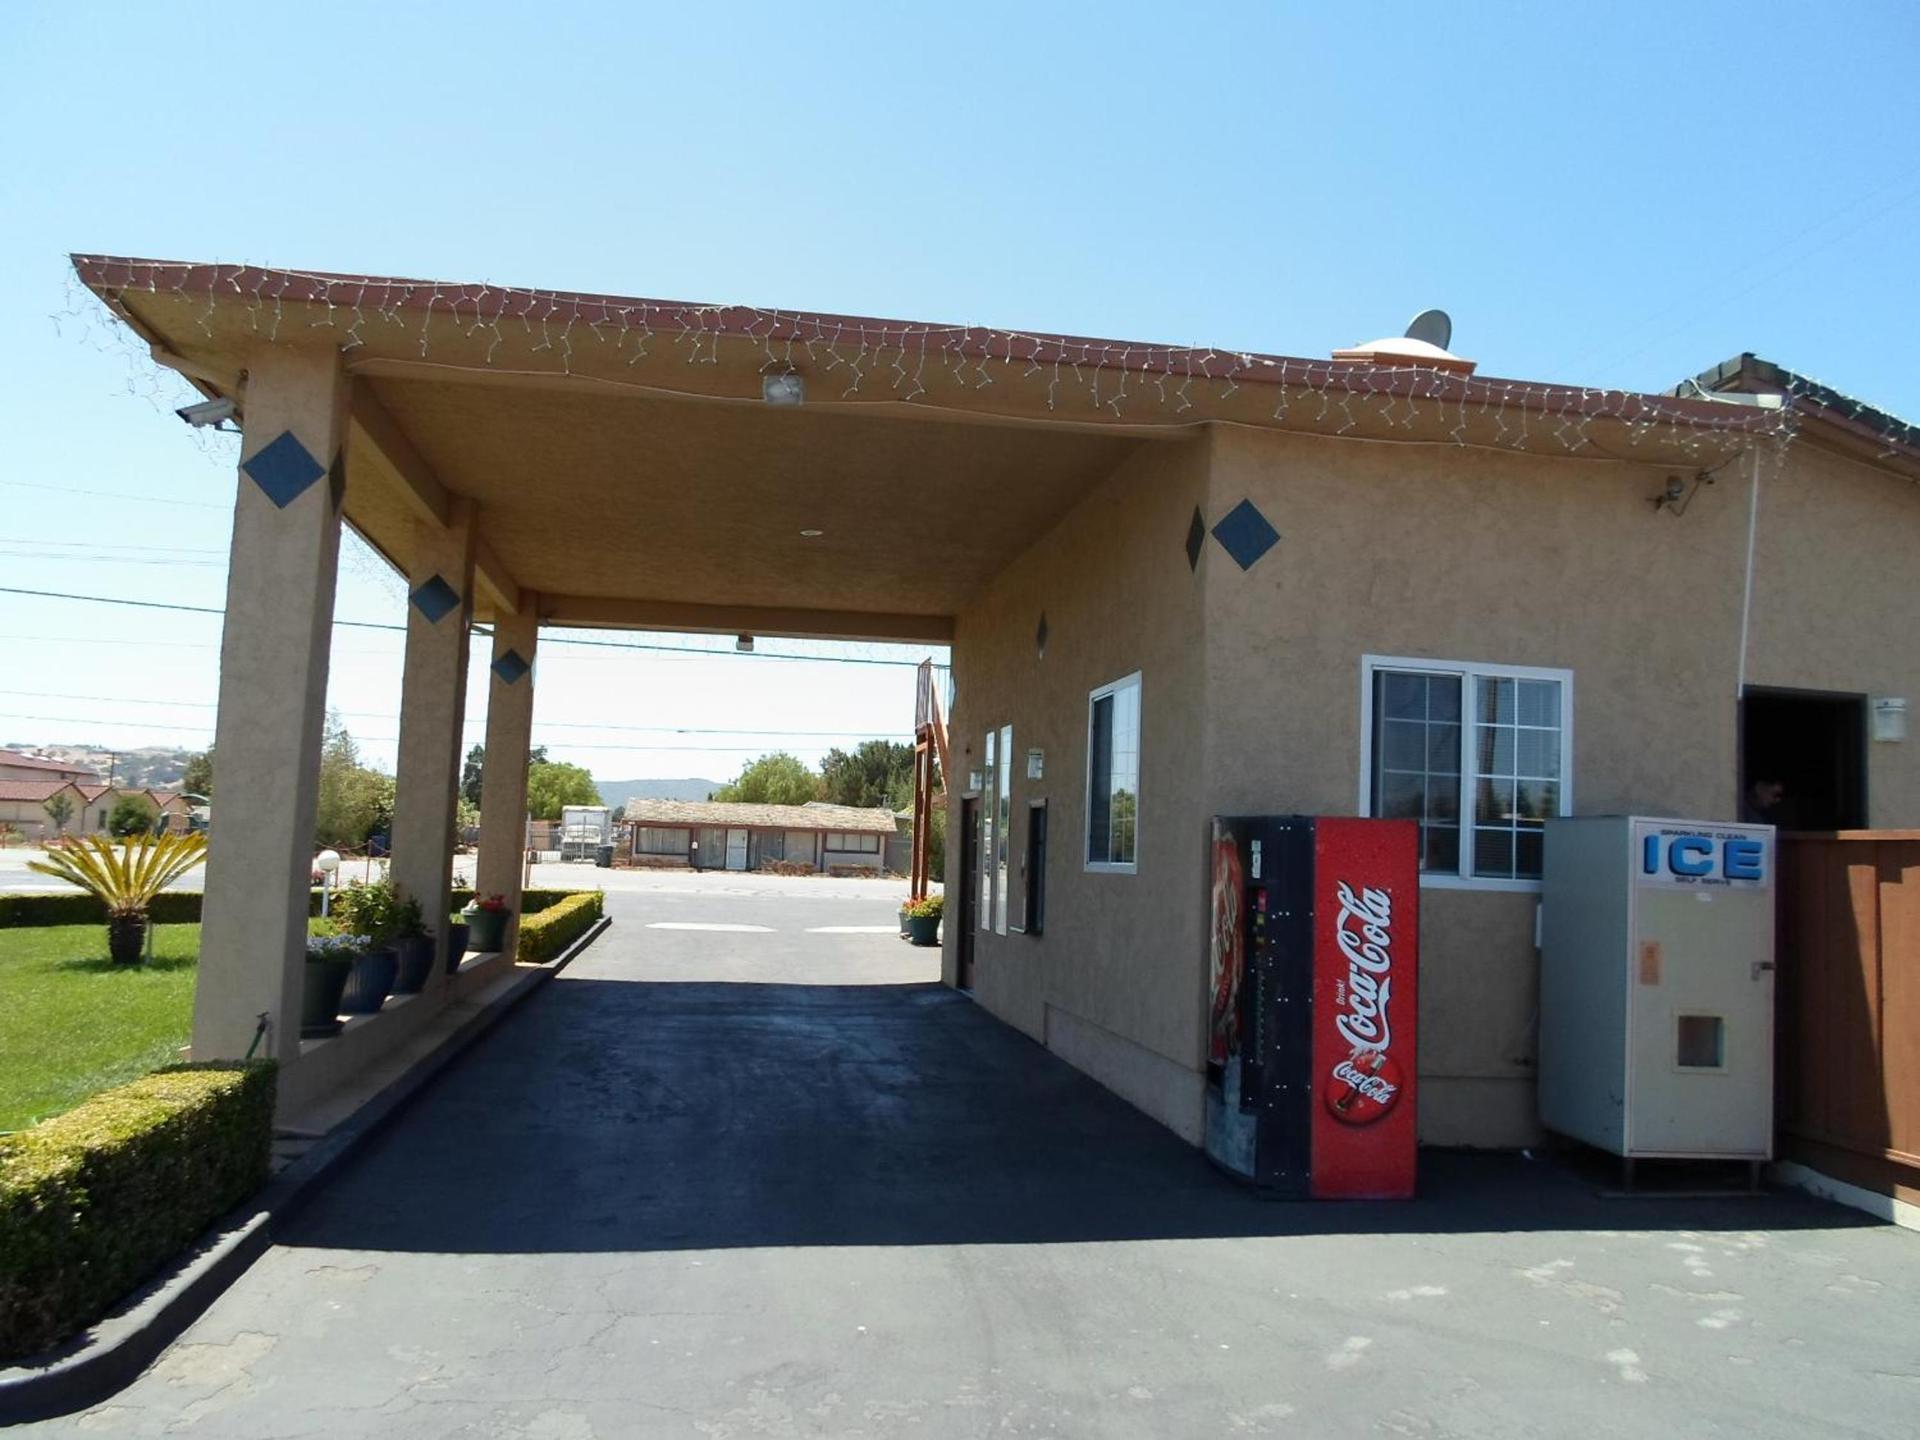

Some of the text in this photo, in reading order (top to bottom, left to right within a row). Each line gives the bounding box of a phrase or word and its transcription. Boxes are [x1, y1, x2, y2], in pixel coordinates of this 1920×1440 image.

[1643, 834, 1763, 880] ICE
[1661, 829, 1747, 840] SPARKLING CLEAN
[1675, 876, 1731, 886] SELF SERVE
[1336, 880, 1392, 1051] Coca-Cola
[1333, 1060, 1397, 1105] Coca-Cola
